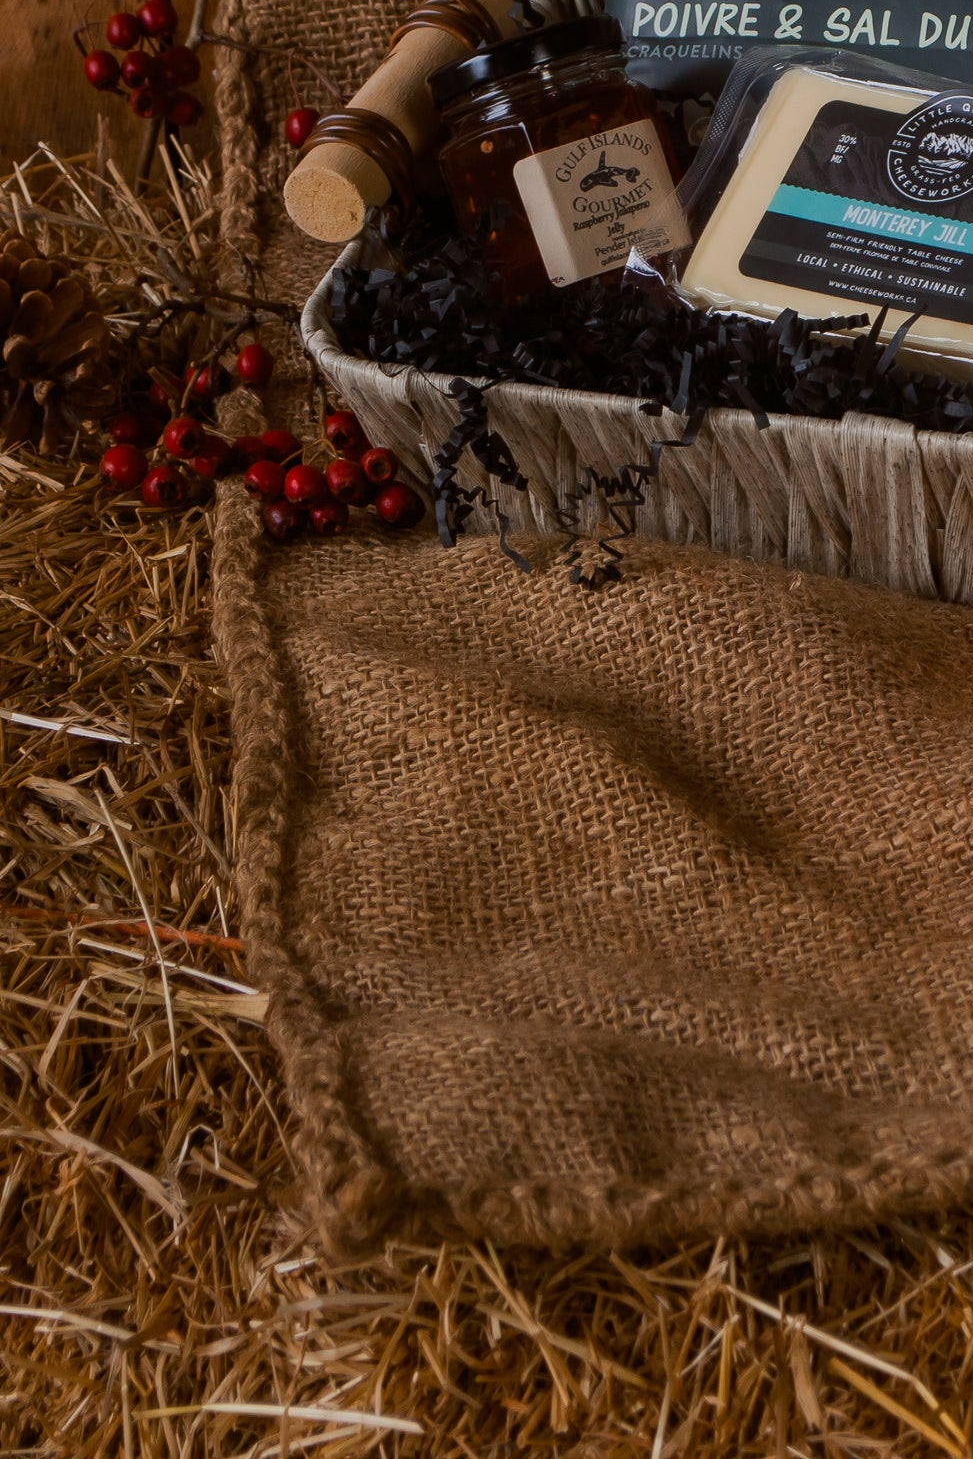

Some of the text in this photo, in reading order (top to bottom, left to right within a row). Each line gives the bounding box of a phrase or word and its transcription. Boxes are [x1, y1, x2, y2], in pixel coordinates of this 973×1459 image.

[632, 1, 761, 38] POIVRE
[773, 4, 804, 40] &
[823, 7, 901, 47] SAL
[918, 12, 972, 51] DU
[627, 44, 744, 61] CRAQUELINS
[907, 103, 953, 132] LITTLE
[838, 133, 857, 145] 30%
[892, 139, 911, 148] ESTD
[555, 132, 653, 182] GULF ISLANDS
[834, 144, 849, 154] BF/
[830, 154, 843, 164] MG
[910, 165, 961, 184] GRASS-FED
[572, 178, 654, 214] GOURMET
[573, 211, 615, 232] Raspberry
[607, 222, 626, 237] Jelly
[842, 204, 968, 247] MONTEREY JILL
[594, 242, 626, 257] Pender
[826, 231, 965, 266] SEMI-FIRM FRIENDLY TABLE CHEESE
[901, 257, 919, 266] TABLE
[796, 253, 968, 297] LOCAL ETHICAL SUSTAINABLE
